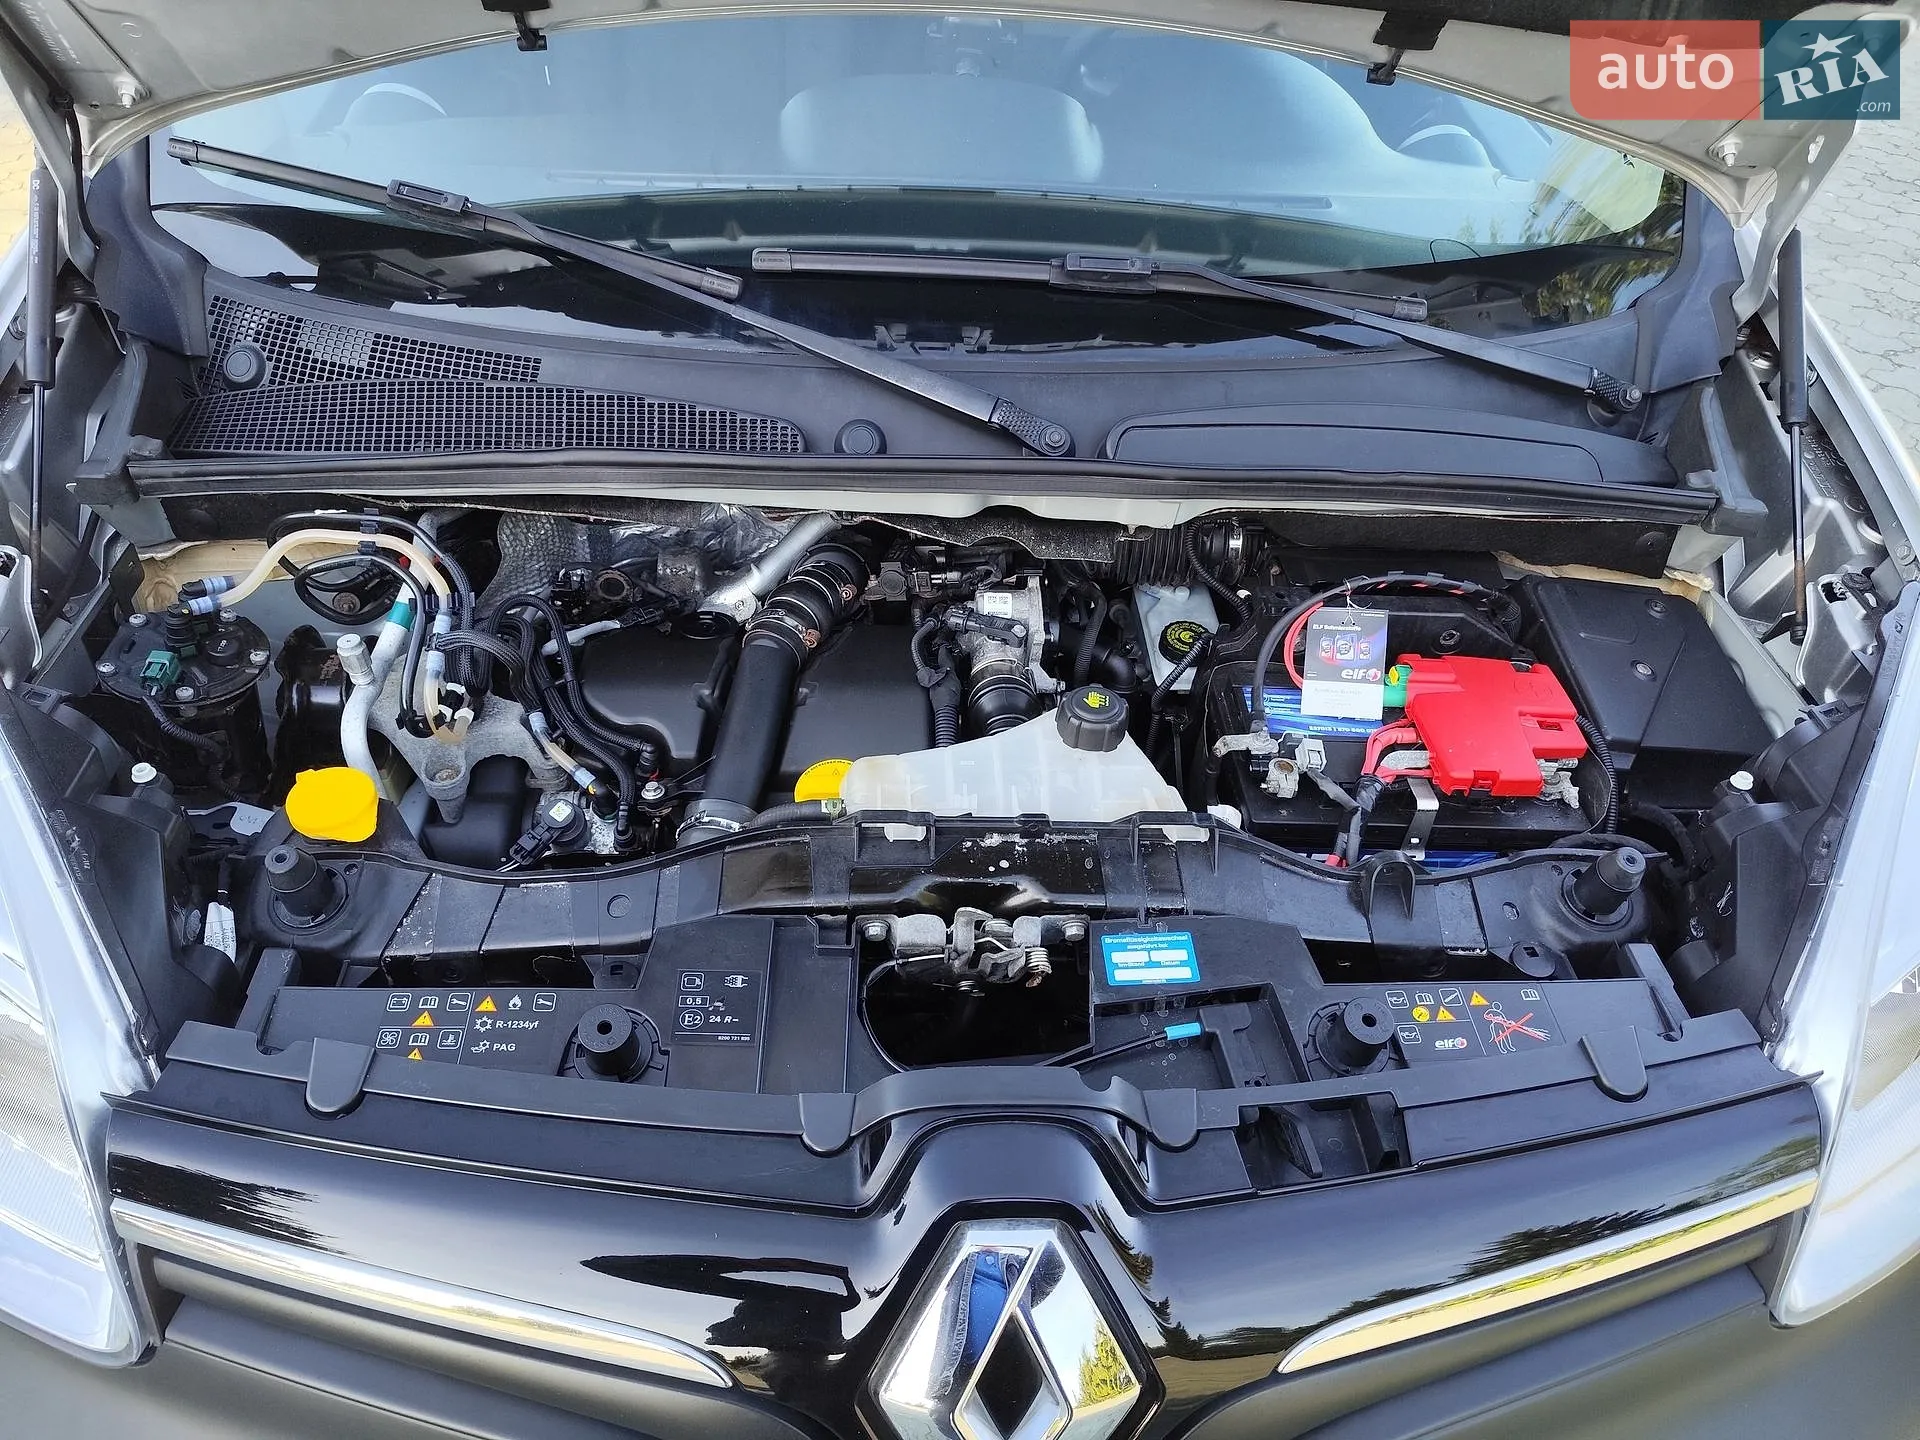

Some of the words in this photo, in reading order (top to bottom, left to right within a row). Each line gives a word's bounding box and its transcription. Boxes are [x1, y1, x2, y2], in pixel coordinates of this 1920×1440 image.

[1341, 668, 1368, 680] elf
[686, 997, 702, 1006] 0,5
[683, 1013, 701, 1026] E2
[708, 1015, 721, 1023] 24
[495, 1020, 539, 1030] R-1234yf
[492, 1043, 516, 1052] PAG
[1435, 1038, 1456, 1048] elf
